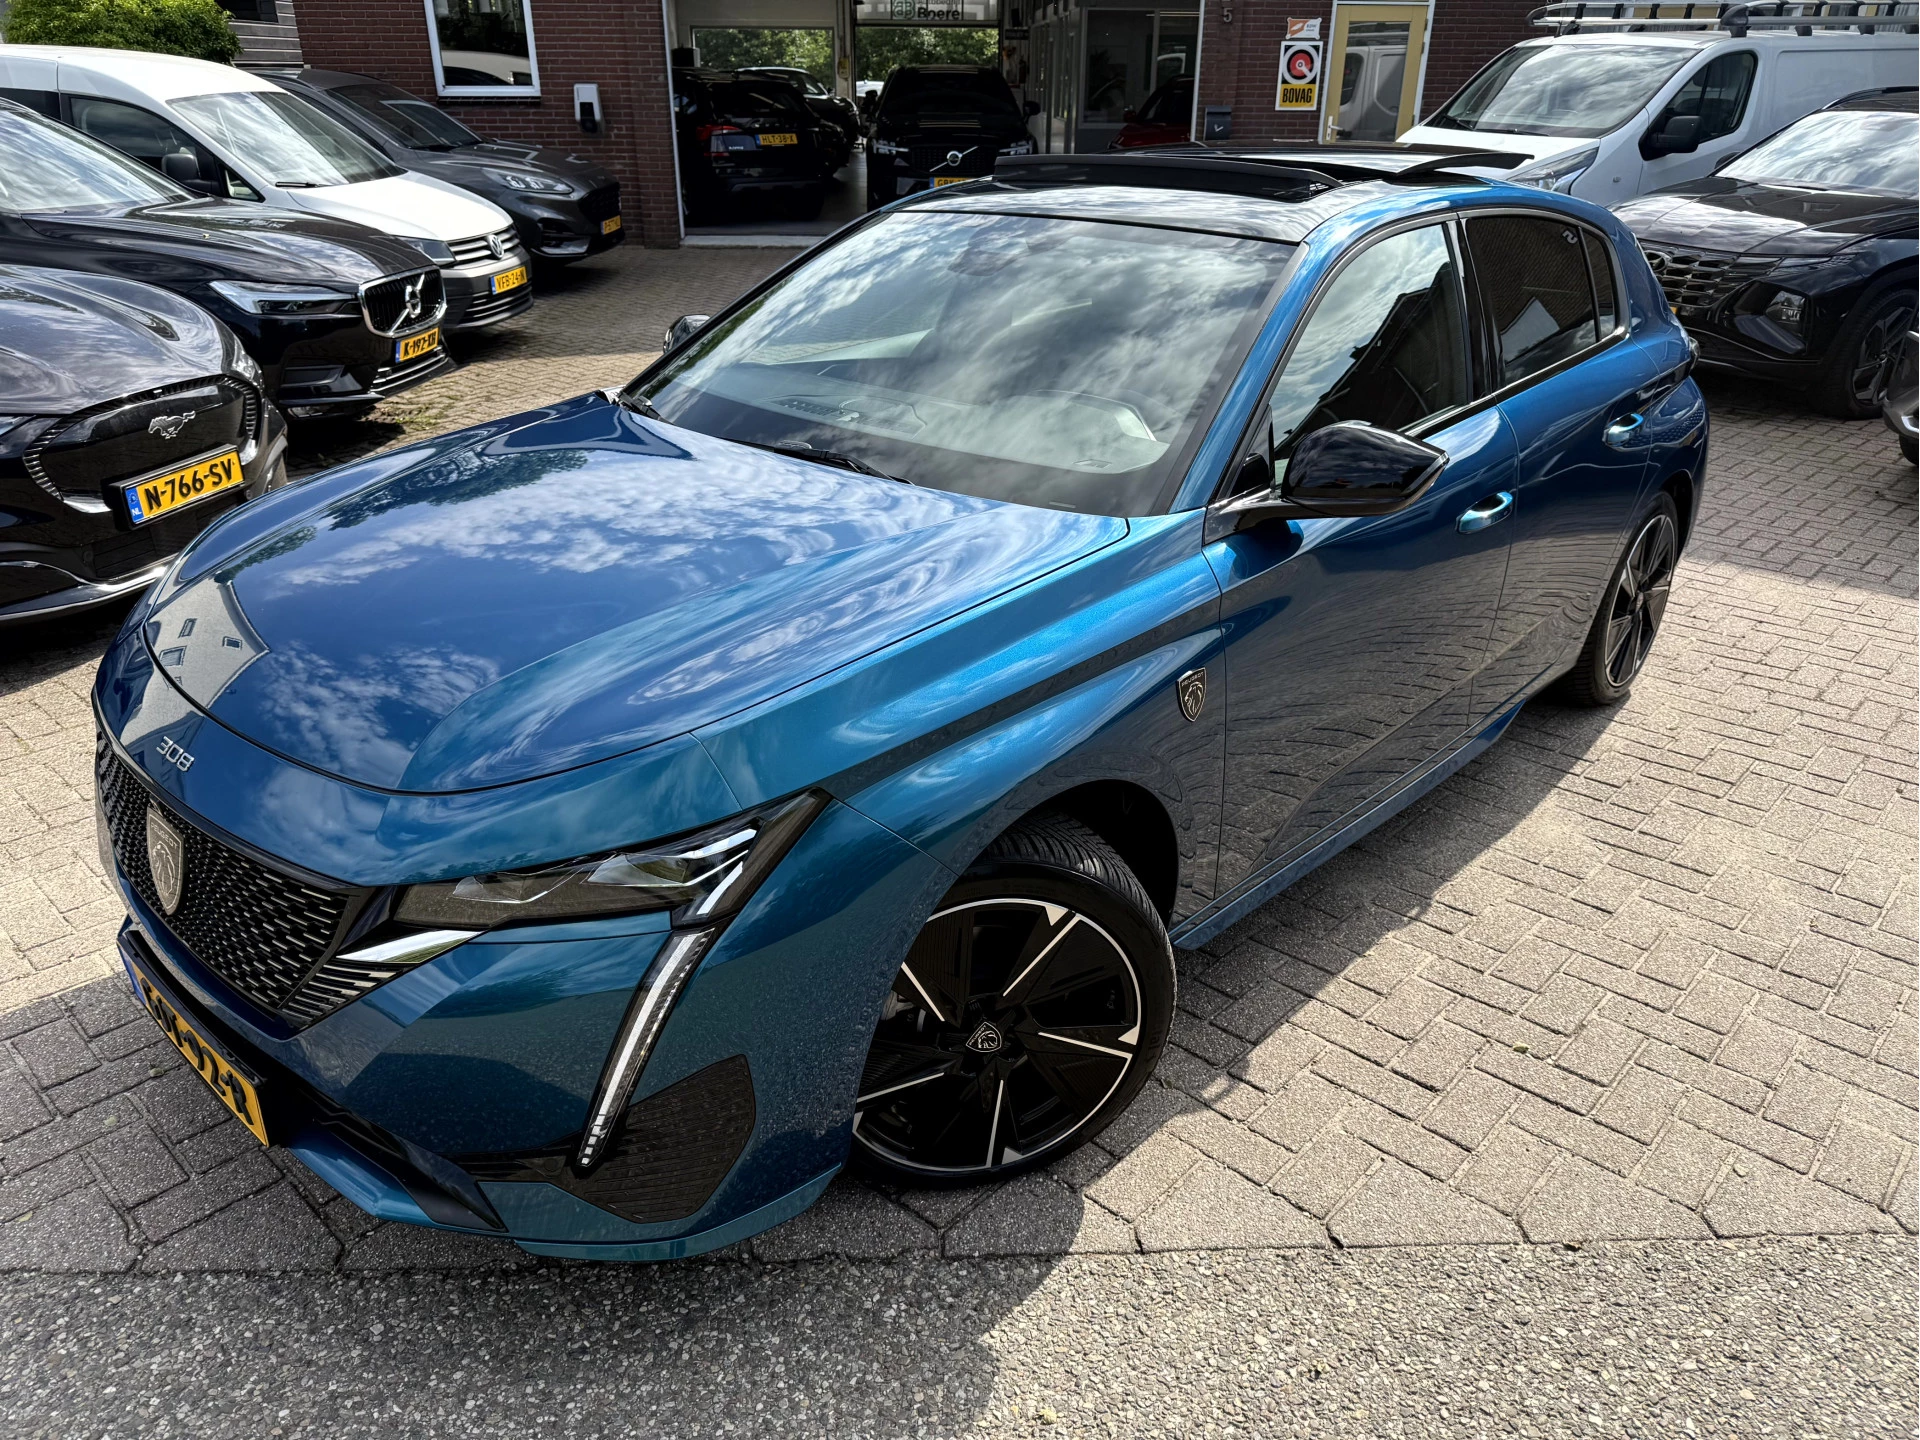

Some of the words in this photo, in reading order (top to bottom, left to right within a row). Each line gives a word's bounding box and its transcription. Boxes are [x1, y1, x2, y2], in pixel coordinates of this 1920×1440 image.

[917, 7, 960, 20] Boere
[1223, 7, 1233, 23] 5
[1282, 87, 1313, 104] BOVAG
[144, 458, 233, 511] N-766-SV
[131, 507, 142, 517] NL
[156, 735, 195, 772] 308
[150, 821, 179, 850] PEUGEOT
